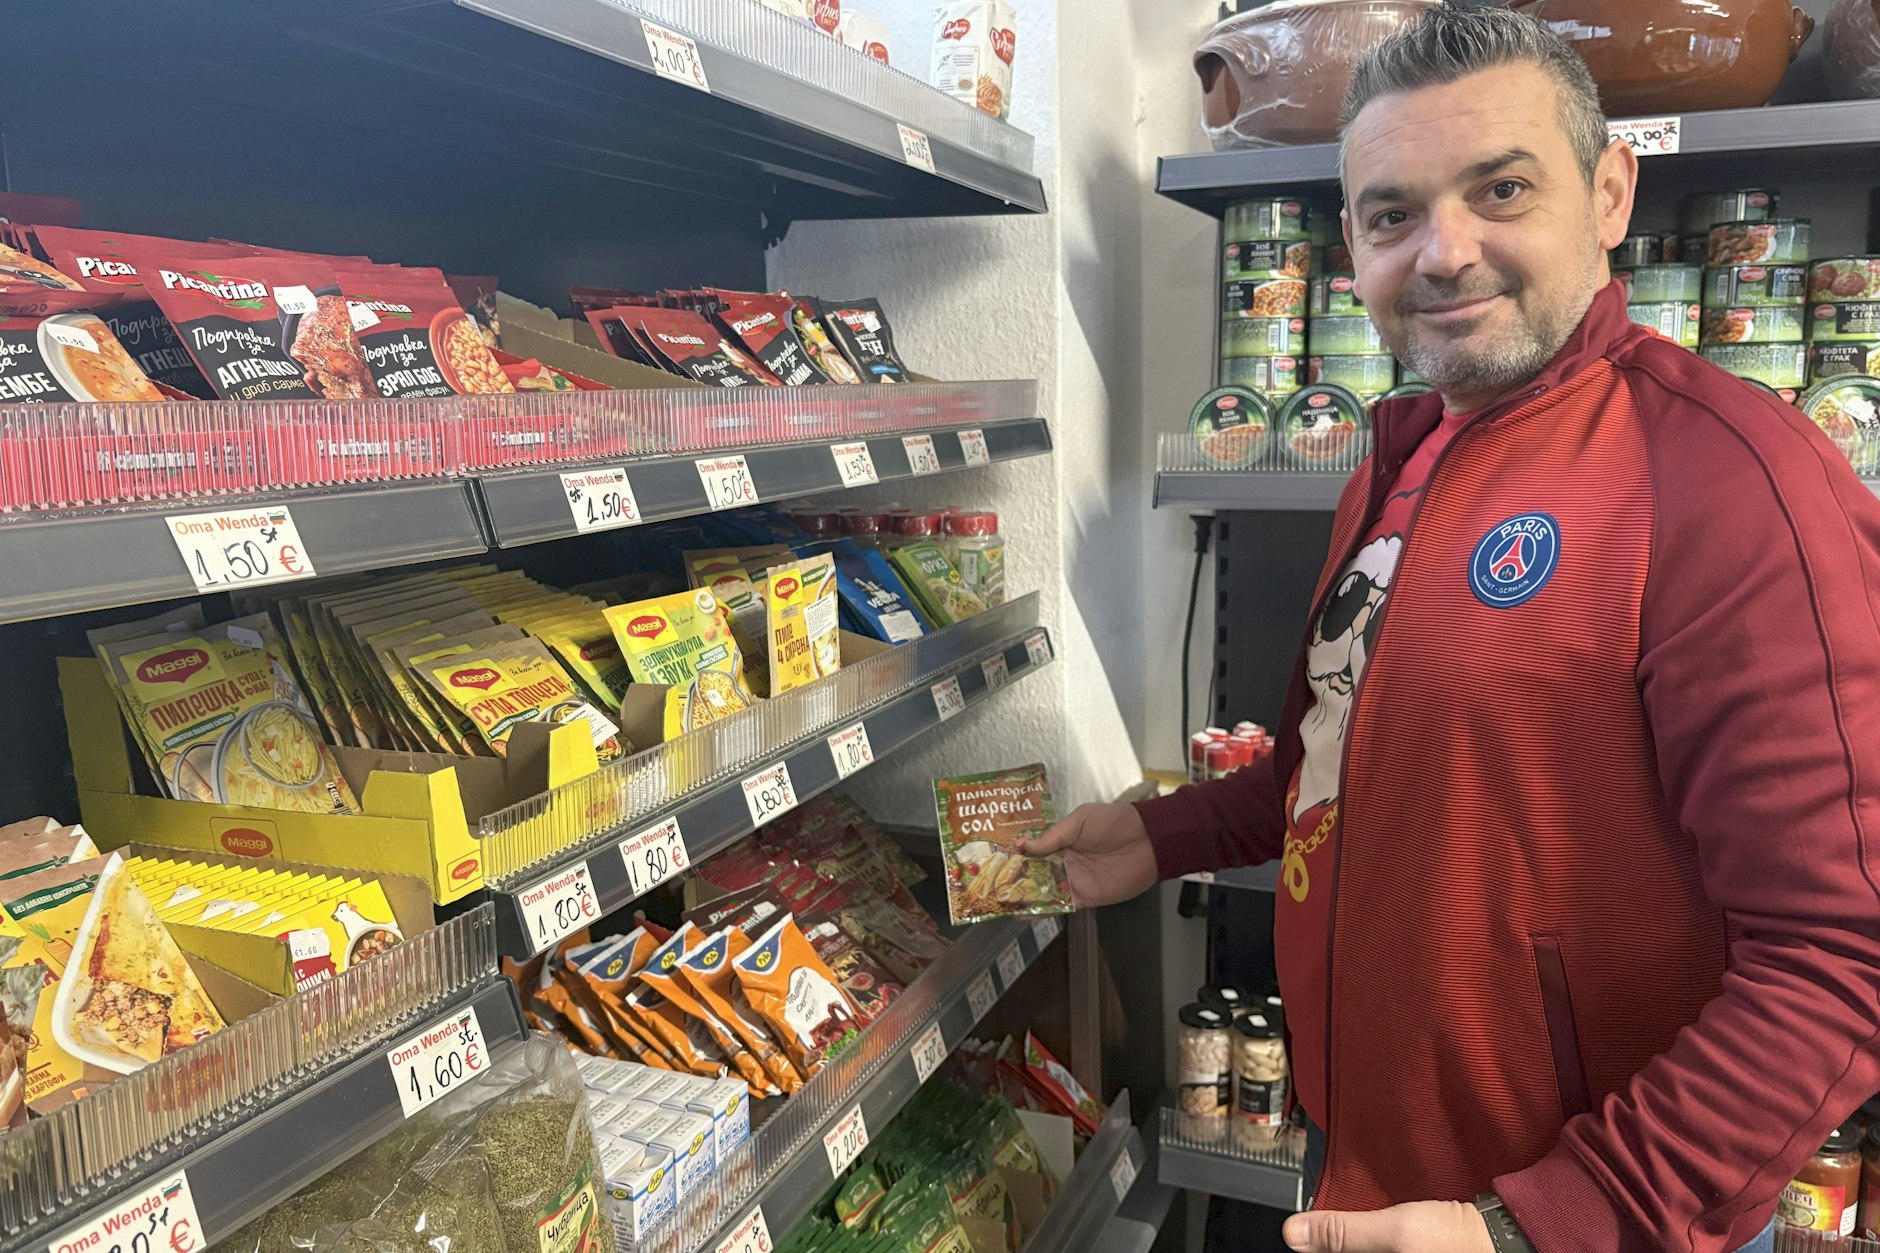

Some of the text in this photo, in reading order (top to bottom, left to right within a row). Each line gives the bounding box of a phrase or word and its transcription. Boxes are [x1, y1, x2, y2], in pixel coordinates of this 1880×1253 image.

[644, 23, 687, 47] Oma Wenda
[652, 41, 704, 86] 2,00 €
[1659, 136, 1673, 151] €
[159, 270, 269, 300] Picantina
[283, 302, 306, 311] €1.50
[732, 311, 777, 336] Picantina
[192, 327, 275, 353] Подправка
[246, 341, 265, 355] за
[657, 332, 706, 346] Picantina
[400, 351, 417, 366] за
[217, 358, 299, 389] АГНЕШКО
[377, 366, 442, 397] ЗРЯЛ БОБ
[275, 378, 306, 393] сарма
[699, 459, 737, 473] Oma Wenda
[865, 464, 875, 480] €
[929, 454, 938, 470] €
[564, 473, 615, 489] Oma Wenda
[707, 477, 755, 508] 1,50 €
[587, 492, 635, 525] 1,50 €
[174, 514, 269, 535] Oma Wenda
[1500, 520, 1547, 540] PARIS
[195, 540, 304, 586] 1,50 €
[922, 557, 948, 574] ОРИЗ
[777, 581, 795, 595] Maggi
[1481, 575, 1530, 593] SAINT GERMAIN
[631, 618, 662, 634] Maggi
[145, 652, 202, 679] Maggi
[777, 649, 784, 664] 4
[456, 670, 496, 685] Maggi
[649, 658, 694, 684] АЗБУКА
[470, 697, 519, 726] СУПА
[830, 729, 857, 746] Oma Wenda
[839, 743, 870, 777] 1,80 €
[744, 770, 778, 791] Oma Wenda
[783, 786, 793, 805] €
[227, 837, 268, 850] Maggi
[623, 827, 668, 855] Oma Wenda
[455, 863, 476, 876] Maggi
[632, 845, 685, 893] 1,80 €
[522, 873, 576, 906] Oma Wenda
[538, 892, 596, 944] 1,80 €
[295, 947, 317, 957] €1.60
[391, 1023, 459, 1066] Oma Wenda
[411, 1043, 483, 1101] 1,60 €
[30, 1073, 67, 1096] КАРТОФИ
[825, 1114, 855, 1146] Oma Wenda
[857, 1127, 865, 1146] €
[57, 1195, 162, 1253] Oma Wenda
[547, 1192, 589, 1242] Чубрица
[169, 1218, 196, 1253] €
[719, 1219, 754, 1253] Oma Wenda
